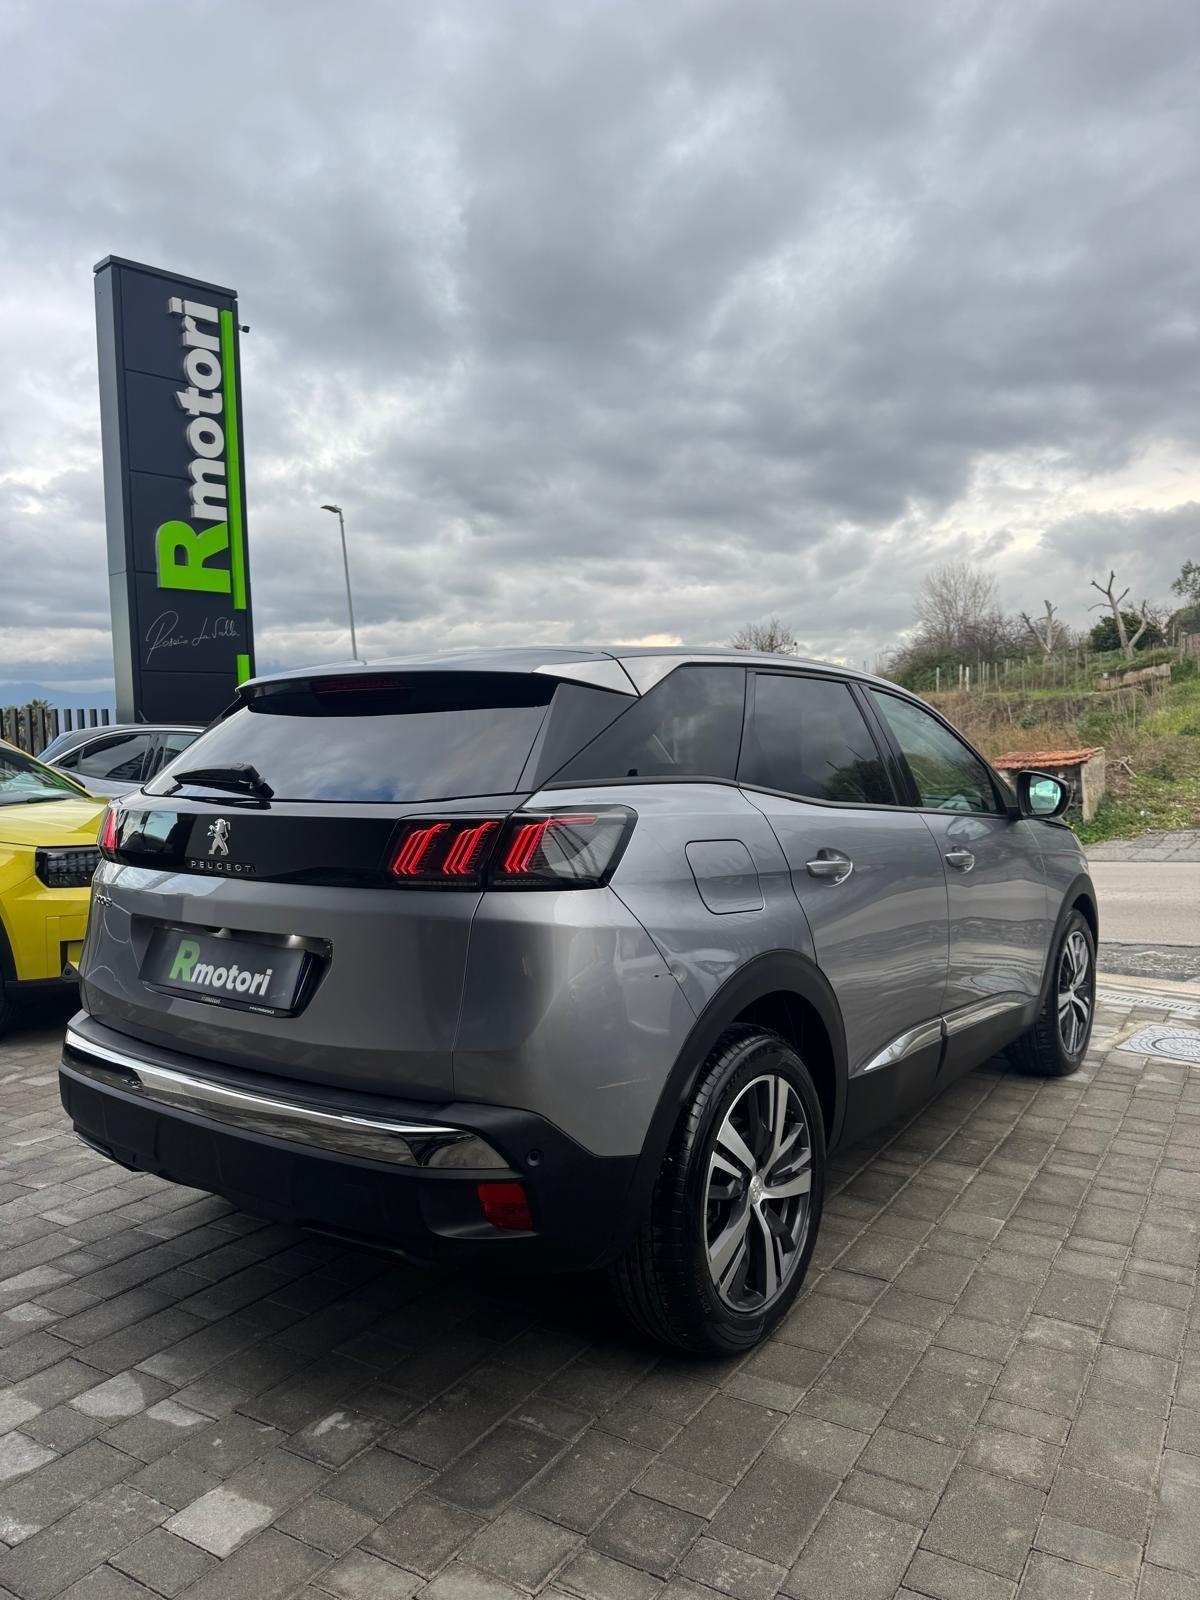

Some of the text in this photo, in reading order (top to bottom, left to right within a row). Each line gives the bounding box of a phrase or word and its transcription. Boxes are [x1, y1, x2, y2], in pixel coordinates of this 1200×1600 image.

[156, 297, 231, 594] Rmotori
[191, 860, 252, 873] PEUGEOT
[169, 939, 273, 996] Rmotori
